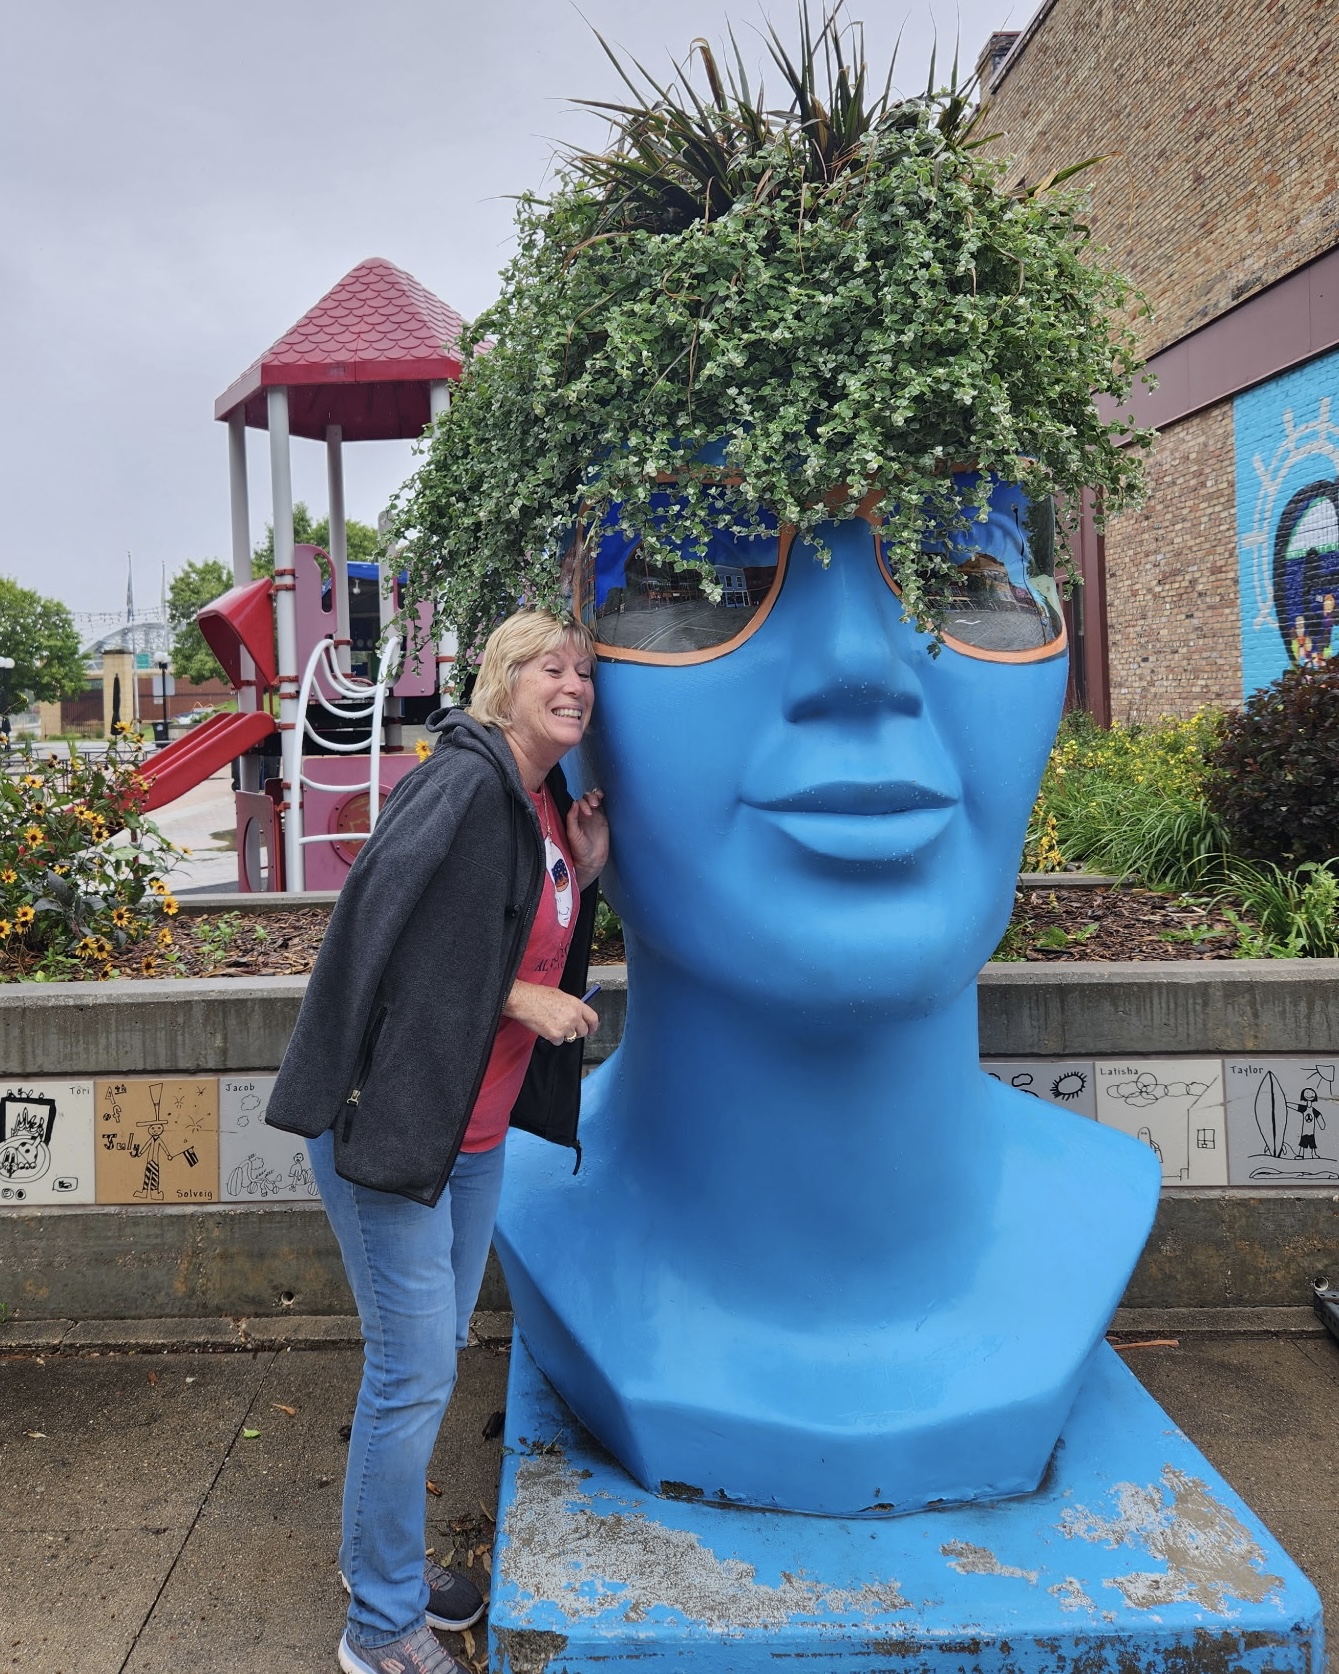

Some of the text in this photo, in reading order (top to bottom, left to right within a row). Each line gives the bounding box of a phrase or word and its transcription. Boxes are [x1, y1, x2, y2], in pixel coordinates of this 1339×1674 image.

[1099, 1066, 1139, 1076] Latisha
[1230, 1065, 1264, 1077] Taylor
[225, 1083, 255, 1092] Jacob
[102, 1105, 122, 1123] of
[102, 1133, 140, 1158] July
[176, 1189, 212, 1201] Solveig
